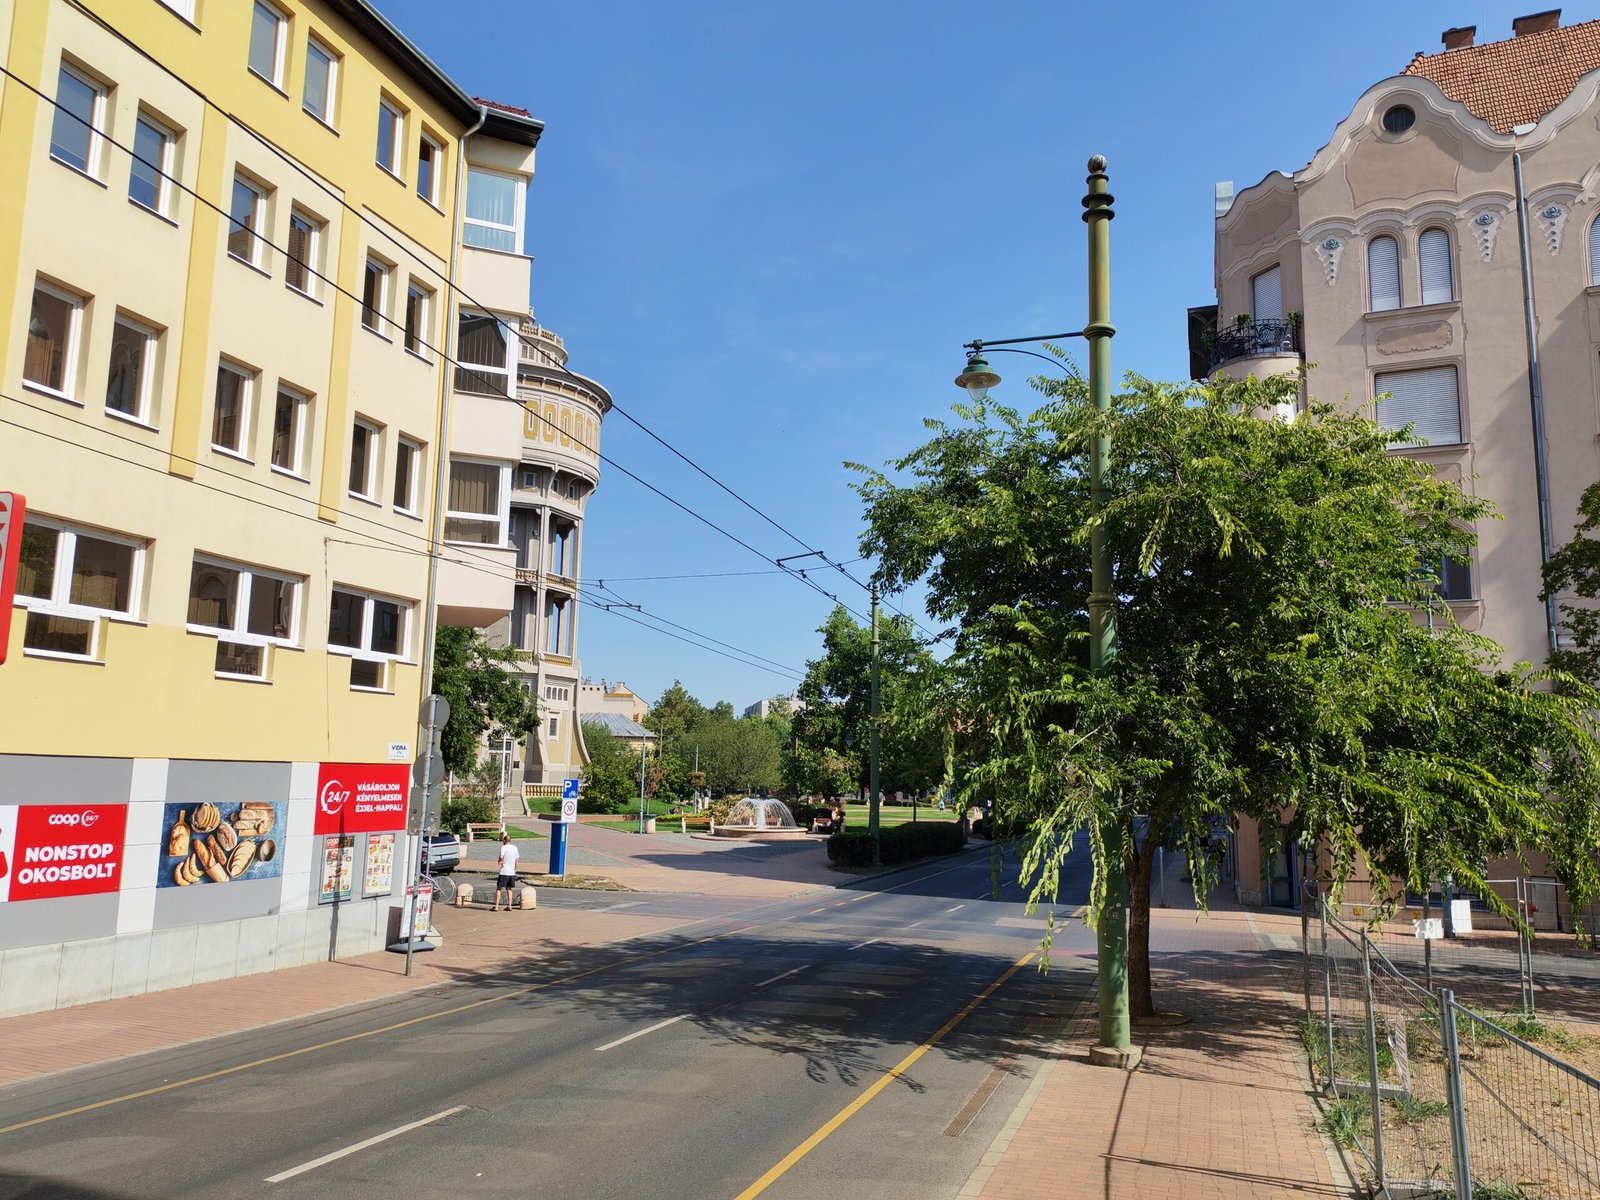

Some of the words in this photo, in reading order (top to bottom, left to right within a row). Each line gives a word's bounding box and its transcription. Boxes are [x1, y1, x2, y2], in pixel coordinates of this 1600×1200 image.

[357, 782, 400, 792] VÁSÁROLJON
[564, 780, 572, 792] P
[327, 790, 351, 803] 24/7
[356, 793, 402, 802] KÉNYELMESEN
[355, 803, 403, 812] ÉJJEL-NAPPAL!
[25, 843, 114, 863] NONSTOP
[18, 862, 116, 884] OKOSBOLT
